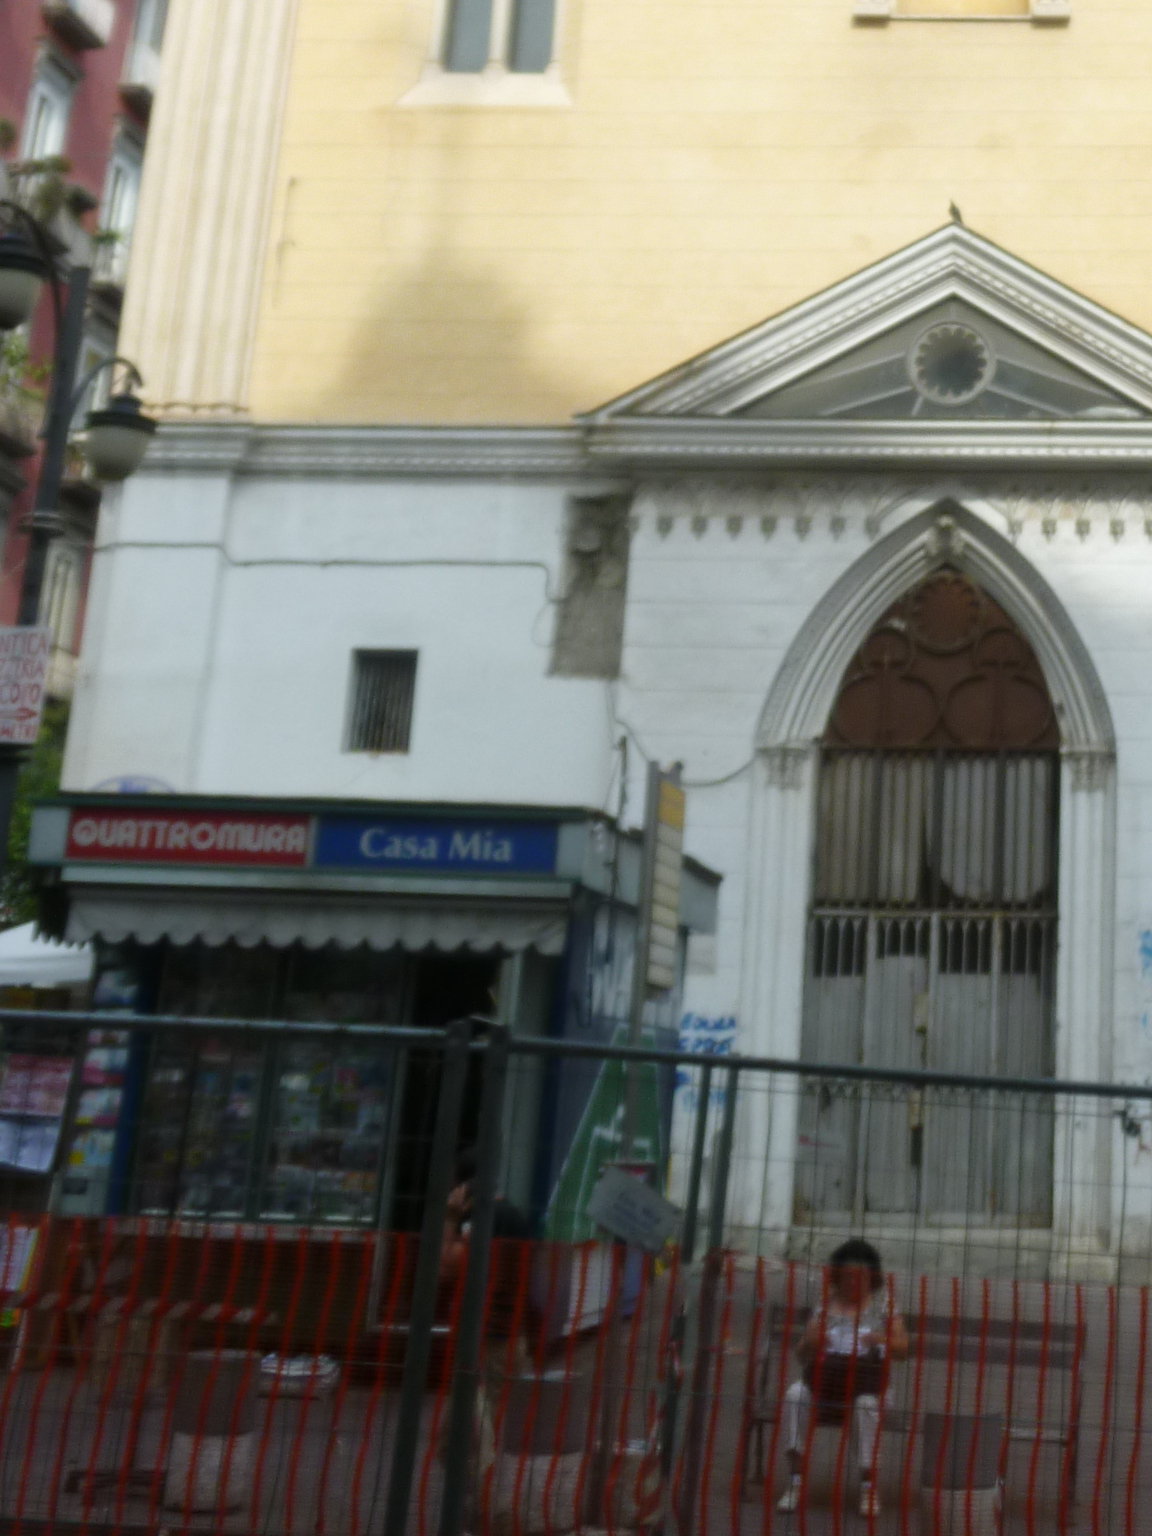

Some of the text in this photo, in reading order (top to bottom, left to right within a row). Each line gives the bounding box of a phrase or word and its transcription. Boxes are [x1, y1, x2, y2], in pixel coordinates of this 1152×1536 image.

[72, 817, 307, 853] QUATTROMURA
[359, 827, 512, 862] Casa Mia
